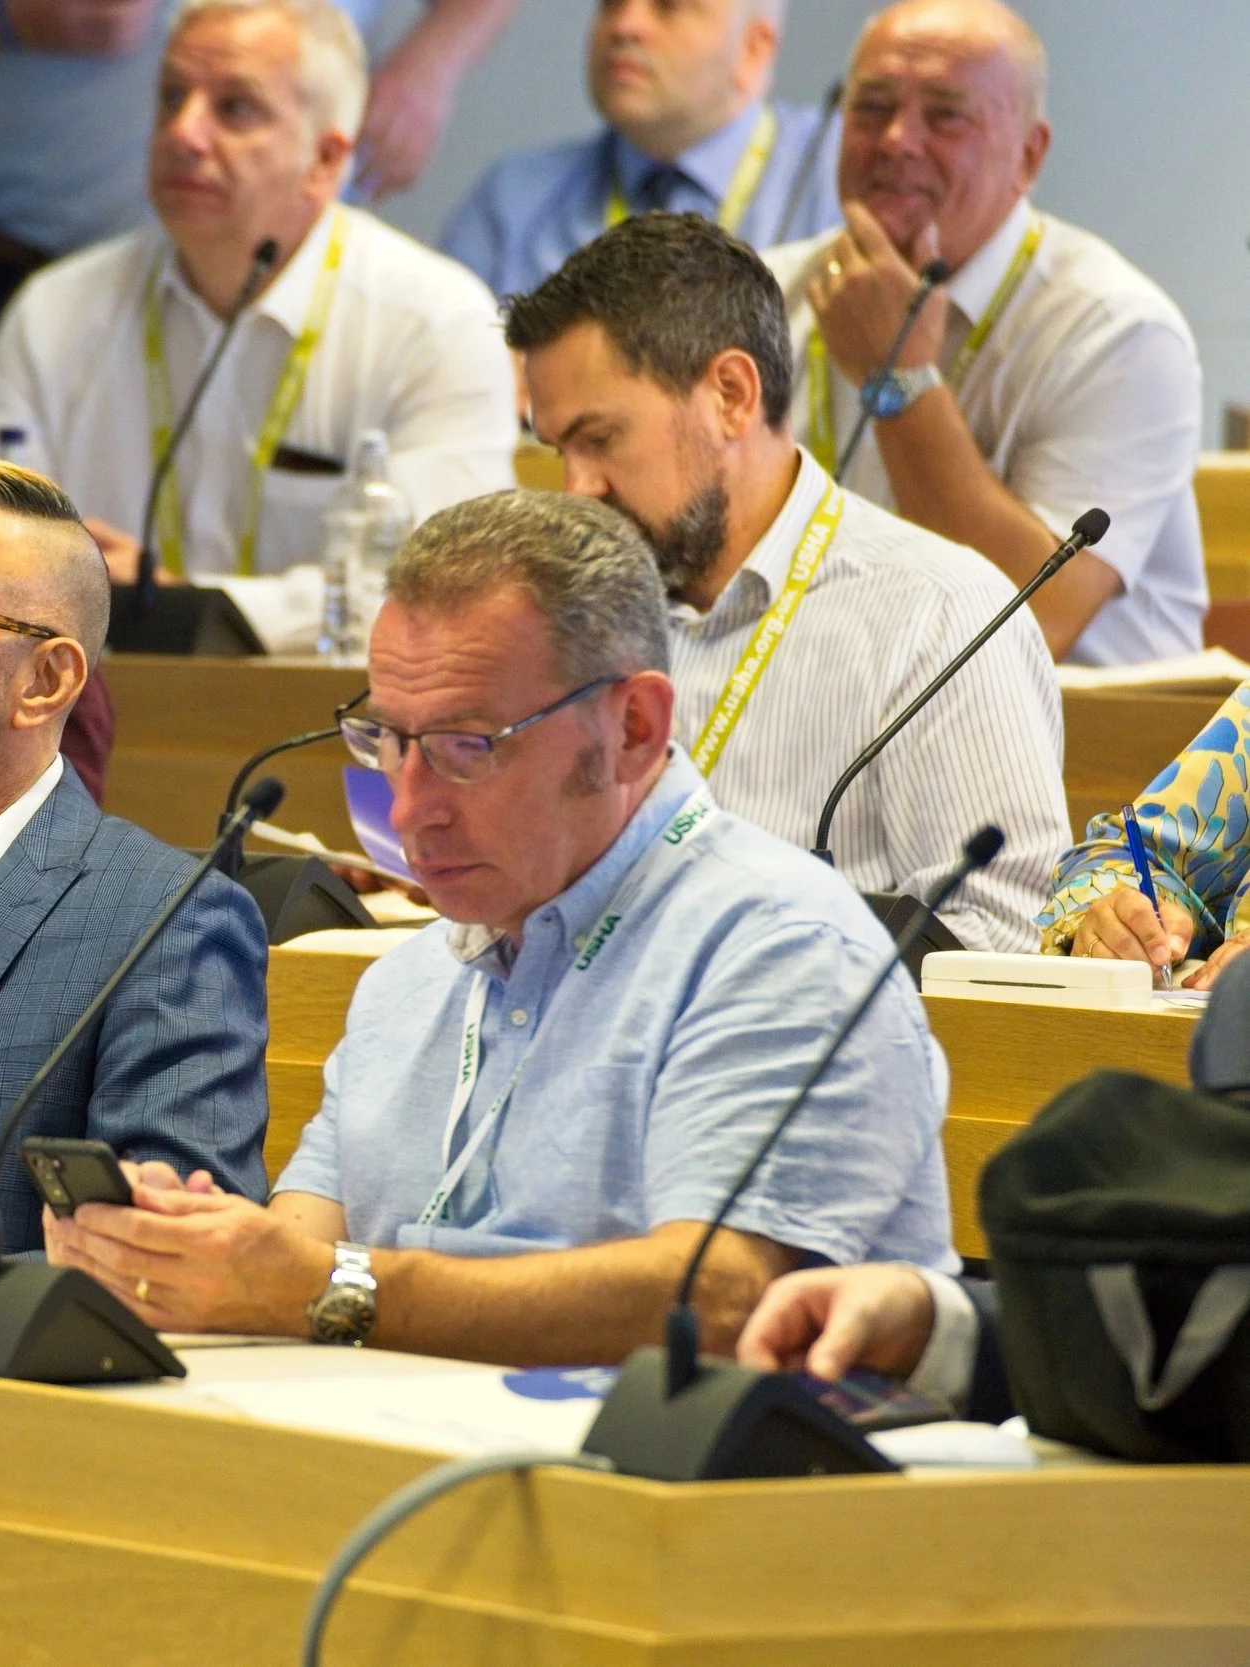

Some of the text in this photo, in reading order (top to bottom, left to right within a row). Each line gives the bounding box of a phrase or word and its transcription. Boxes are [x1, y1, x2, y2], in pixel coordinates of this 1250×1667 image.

[695, 522, 830, 773] www.usha.org.uk USHA
[576, 914, 622, 971] USHA
